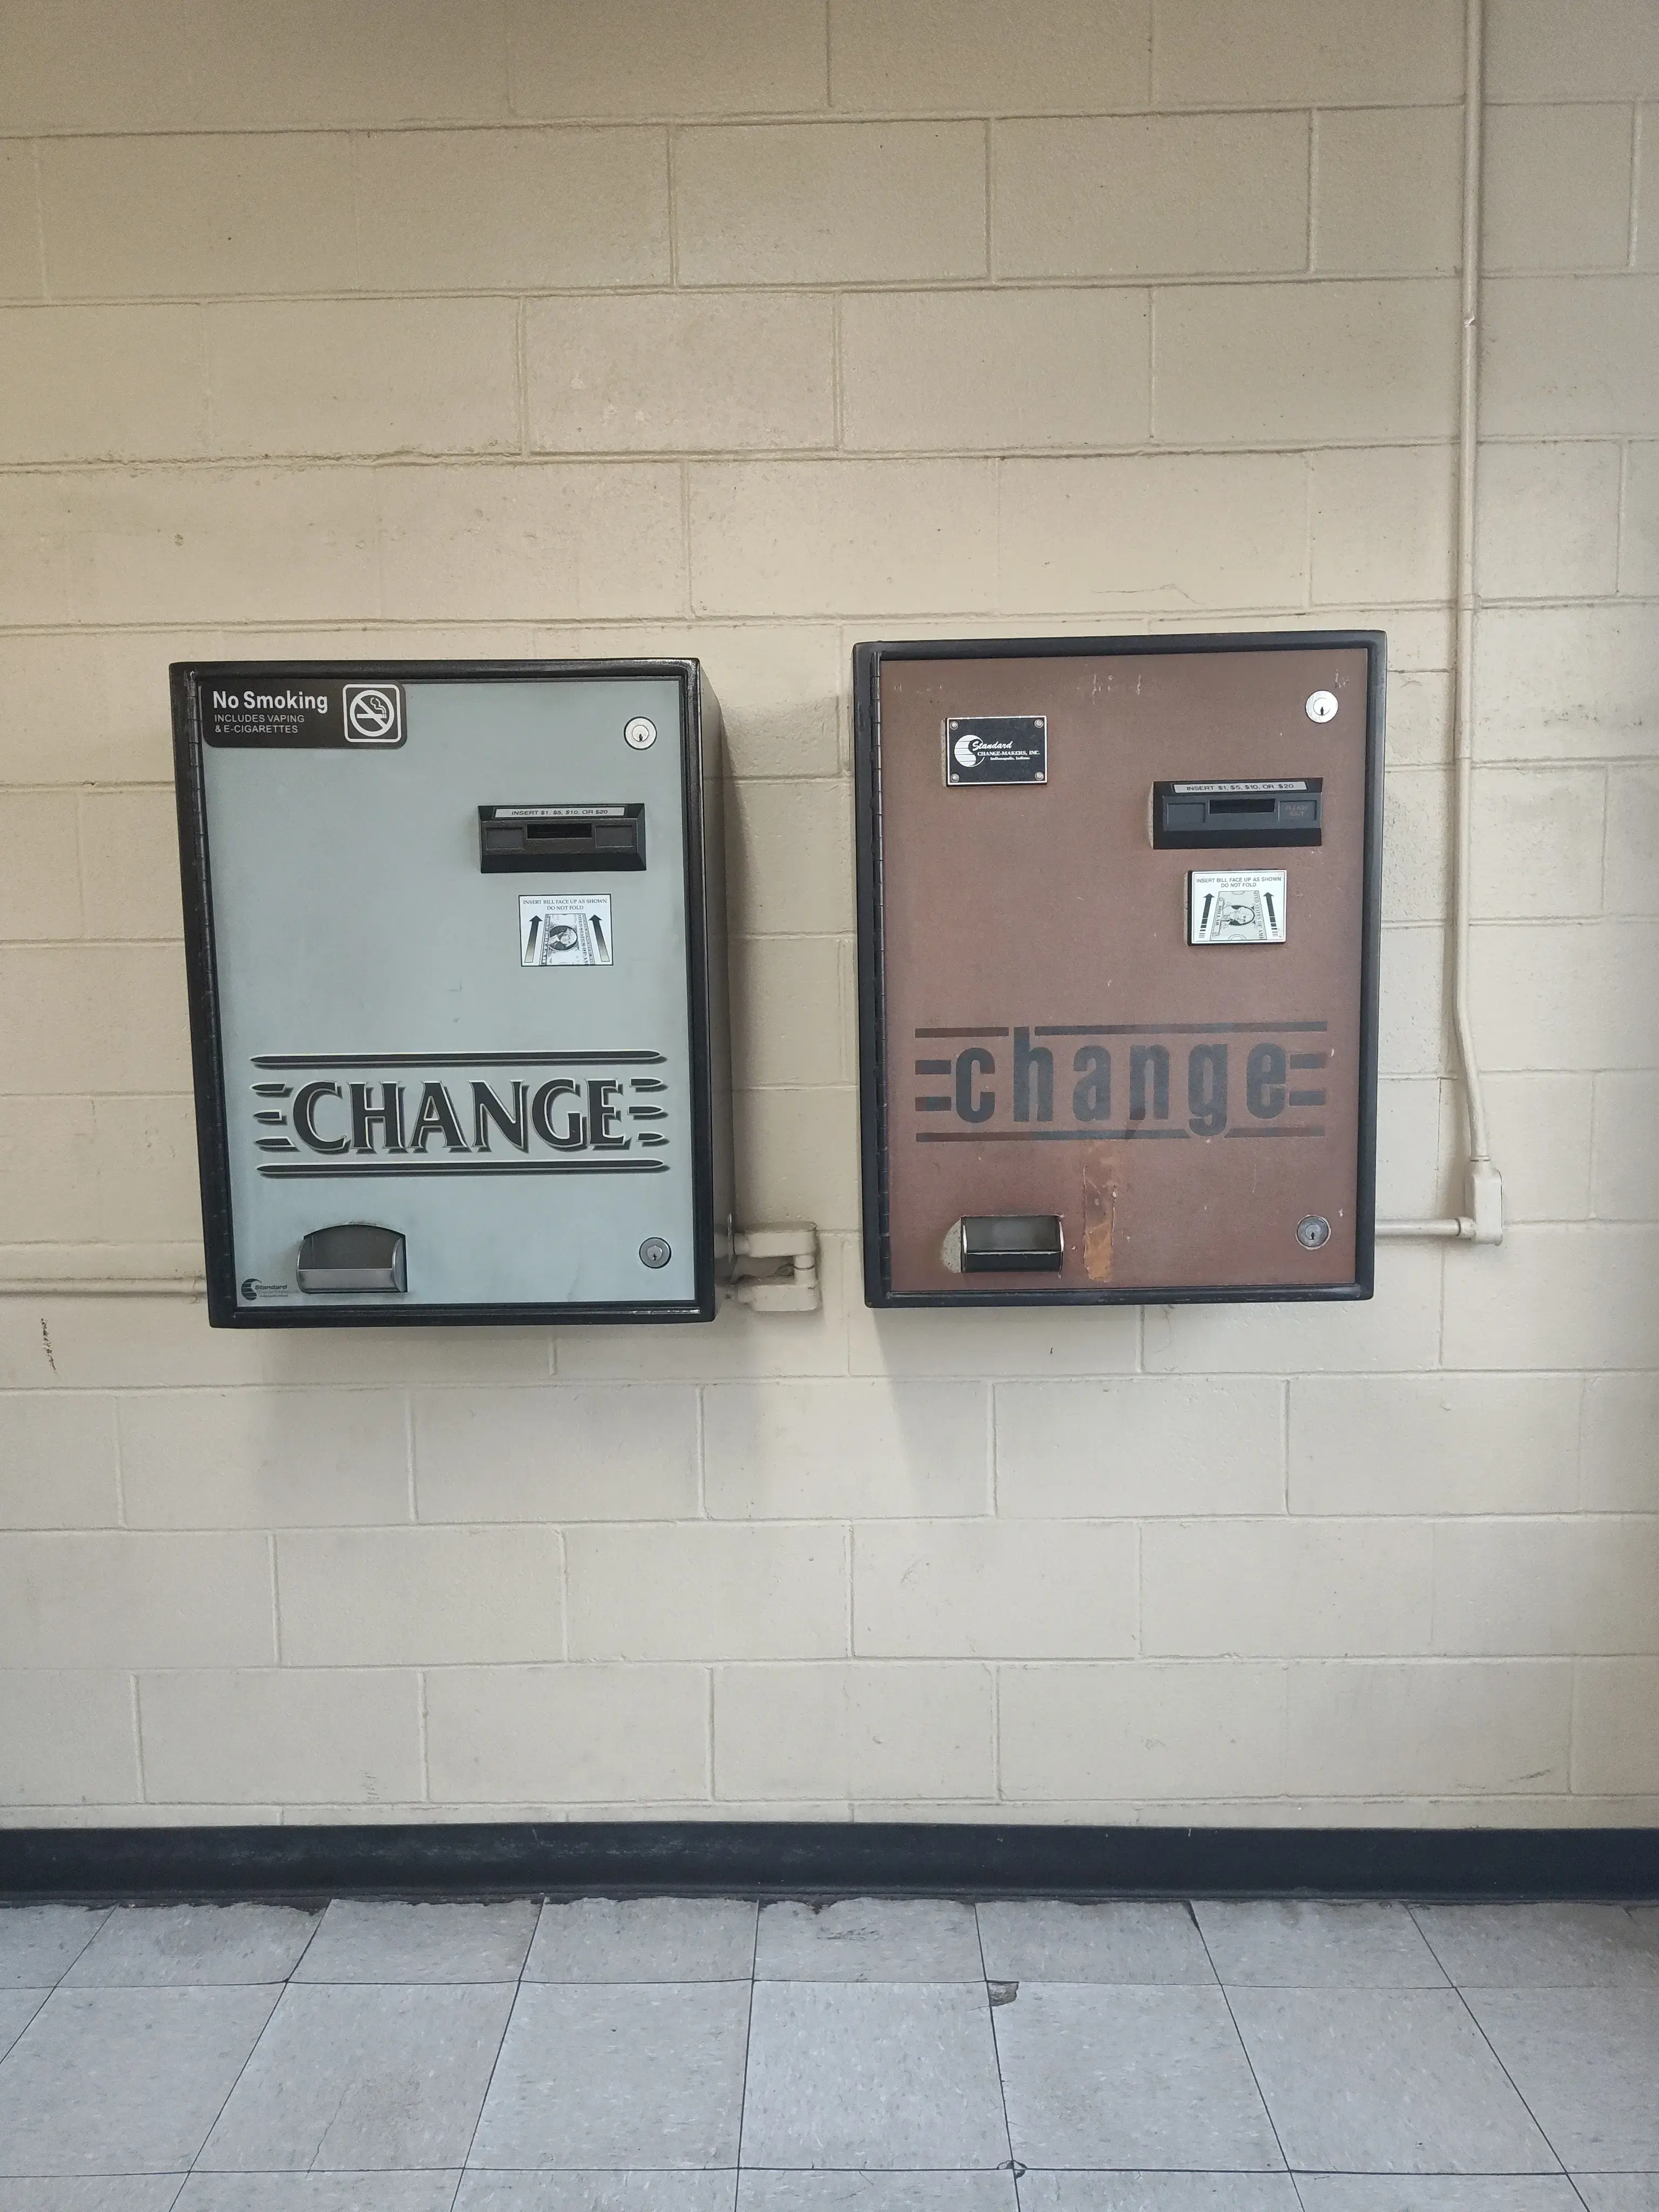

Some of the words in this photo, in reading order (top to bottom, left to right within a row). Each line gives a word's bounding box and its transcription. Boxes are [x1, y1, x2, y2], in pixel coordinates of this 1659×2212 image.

[213, 691, 239, 709] No
[244, 690, 328, 714] Smoking
[214, 714, 265, 723] INCLUDES
[267, 714, 305, 723] VAPING
[224, 725, 299, 733] E-CIGARETTES
[972, 740, 1013, 751] Standard
[955, 1026, 1286, 1137] change
[292, 1077, 630, 1154] CHANGE
